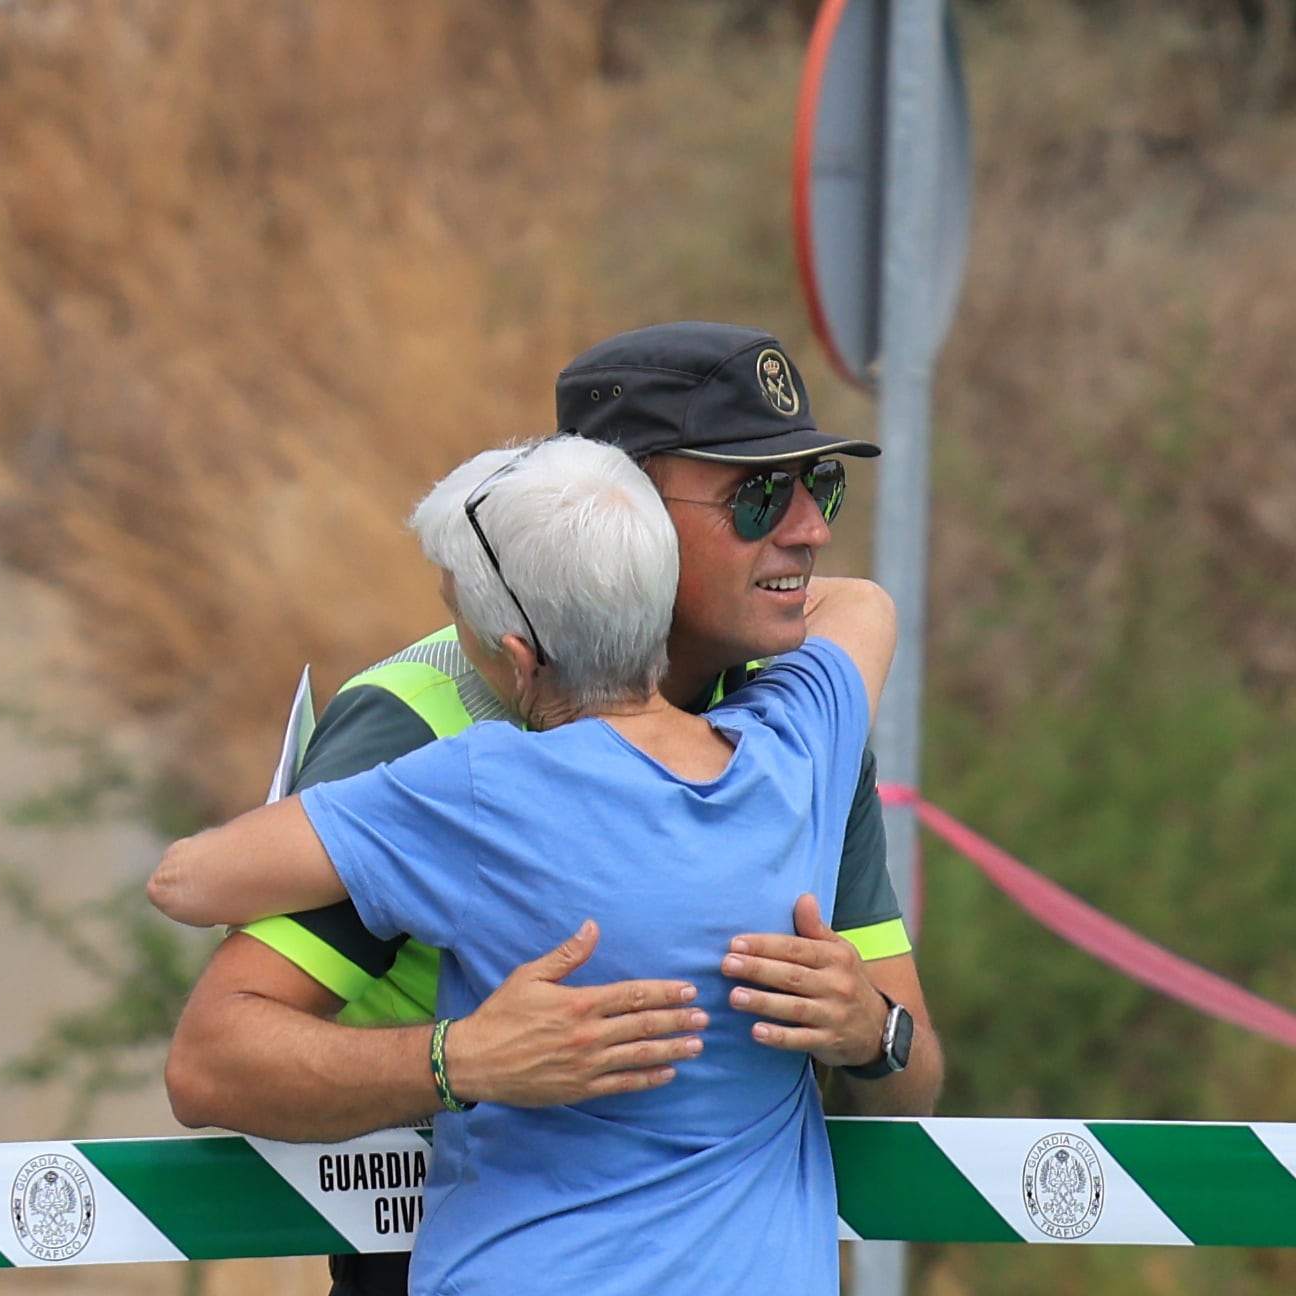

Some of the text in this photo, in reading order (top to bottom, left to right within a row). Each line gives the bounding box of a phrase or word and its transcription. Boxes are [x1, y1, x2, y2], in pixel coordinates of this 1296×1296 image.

[1027, 1135, 1097, 1169] GUARDIA CIVIL
[15, 1157, 87, 1191] GUARDIA CIVIL
[319, 1150, 426, 1192] GUARDIA
[1039, 1220, 1091, 1238] TRAFICO
[28, 1240, 82, 1258] TRAFICO
